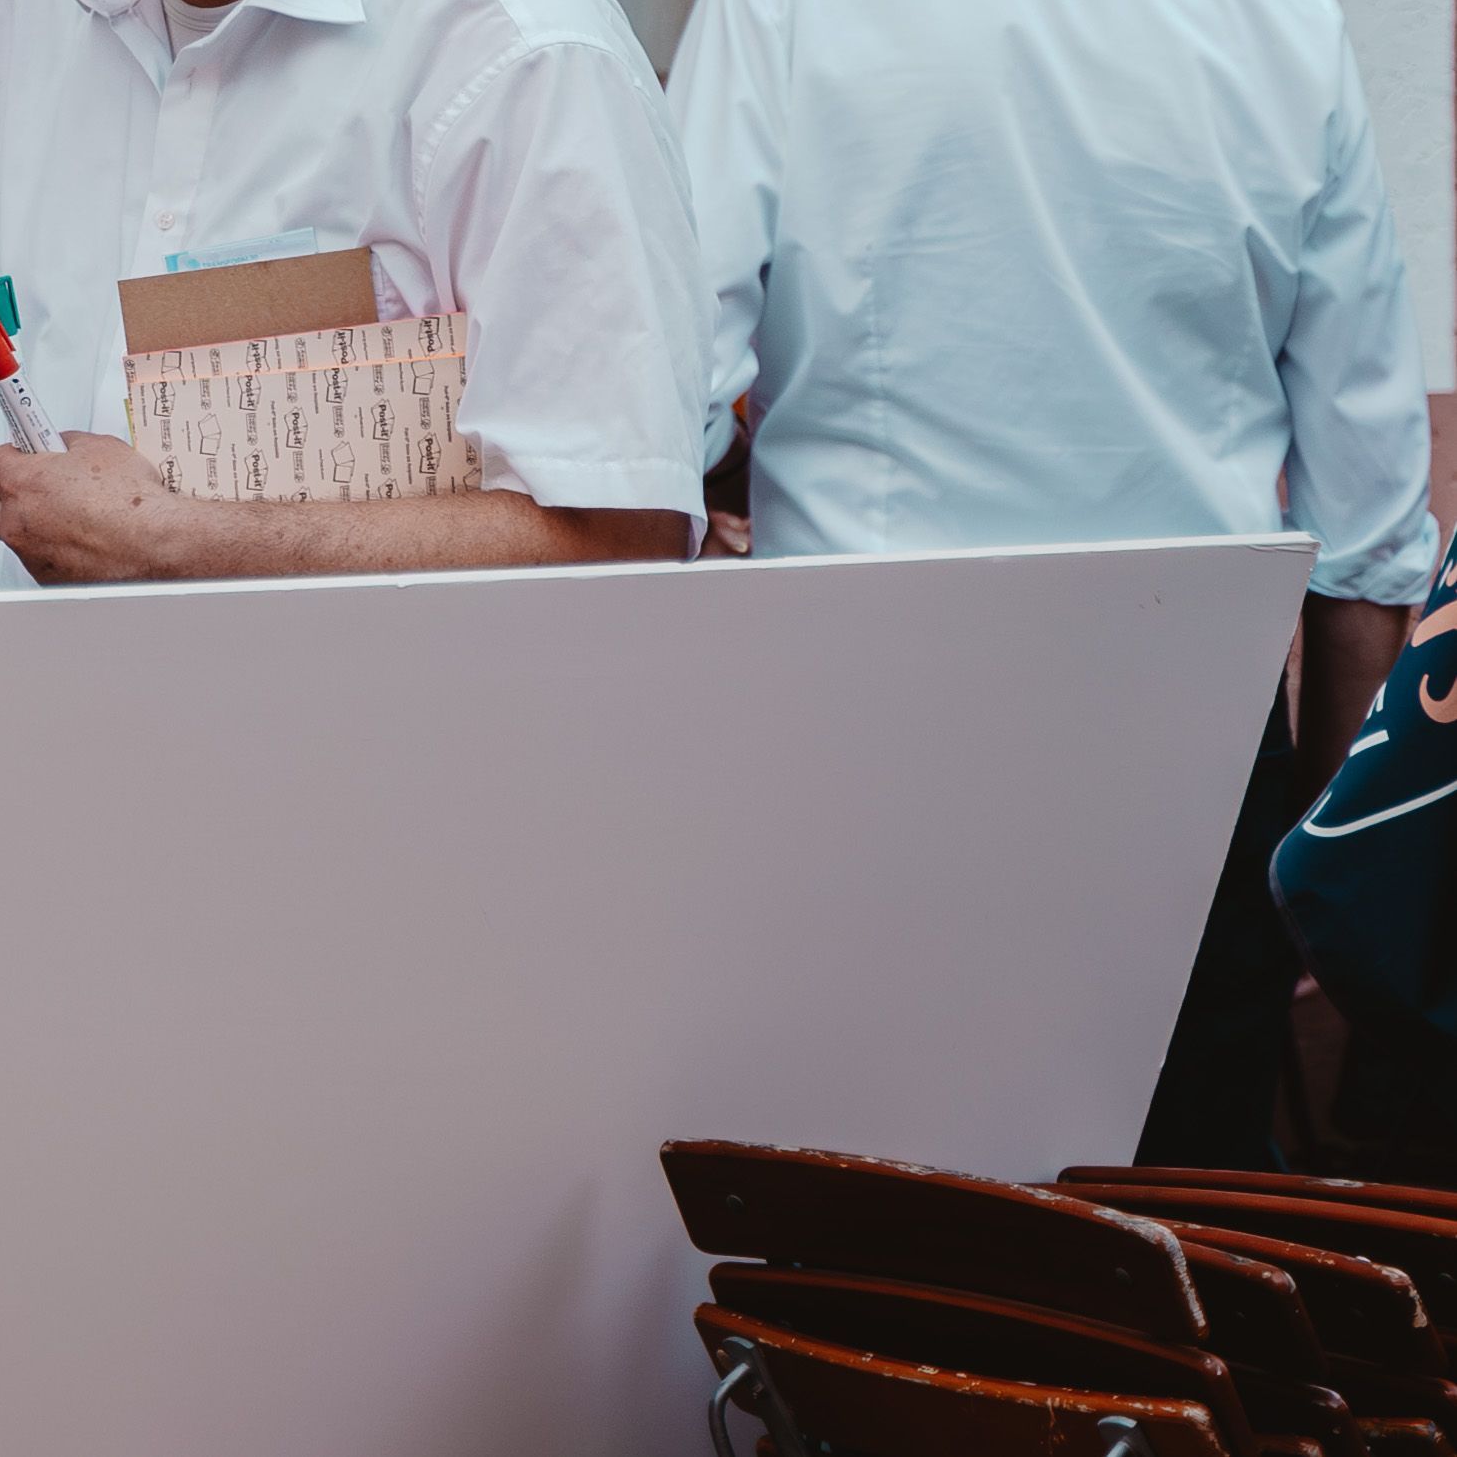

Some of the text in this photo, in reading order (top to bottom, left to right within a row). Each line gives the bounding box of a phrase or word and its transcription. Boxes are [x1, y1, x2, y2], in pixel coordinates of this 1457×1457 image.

[244, 375, 254, 408] Post-it
[292, 412, 302, 445] Post-it
[378, 404, 389, 438] Post-it
[251, 454, 261, 487] Post-it
[424, 438, 435, 471] Post-it
